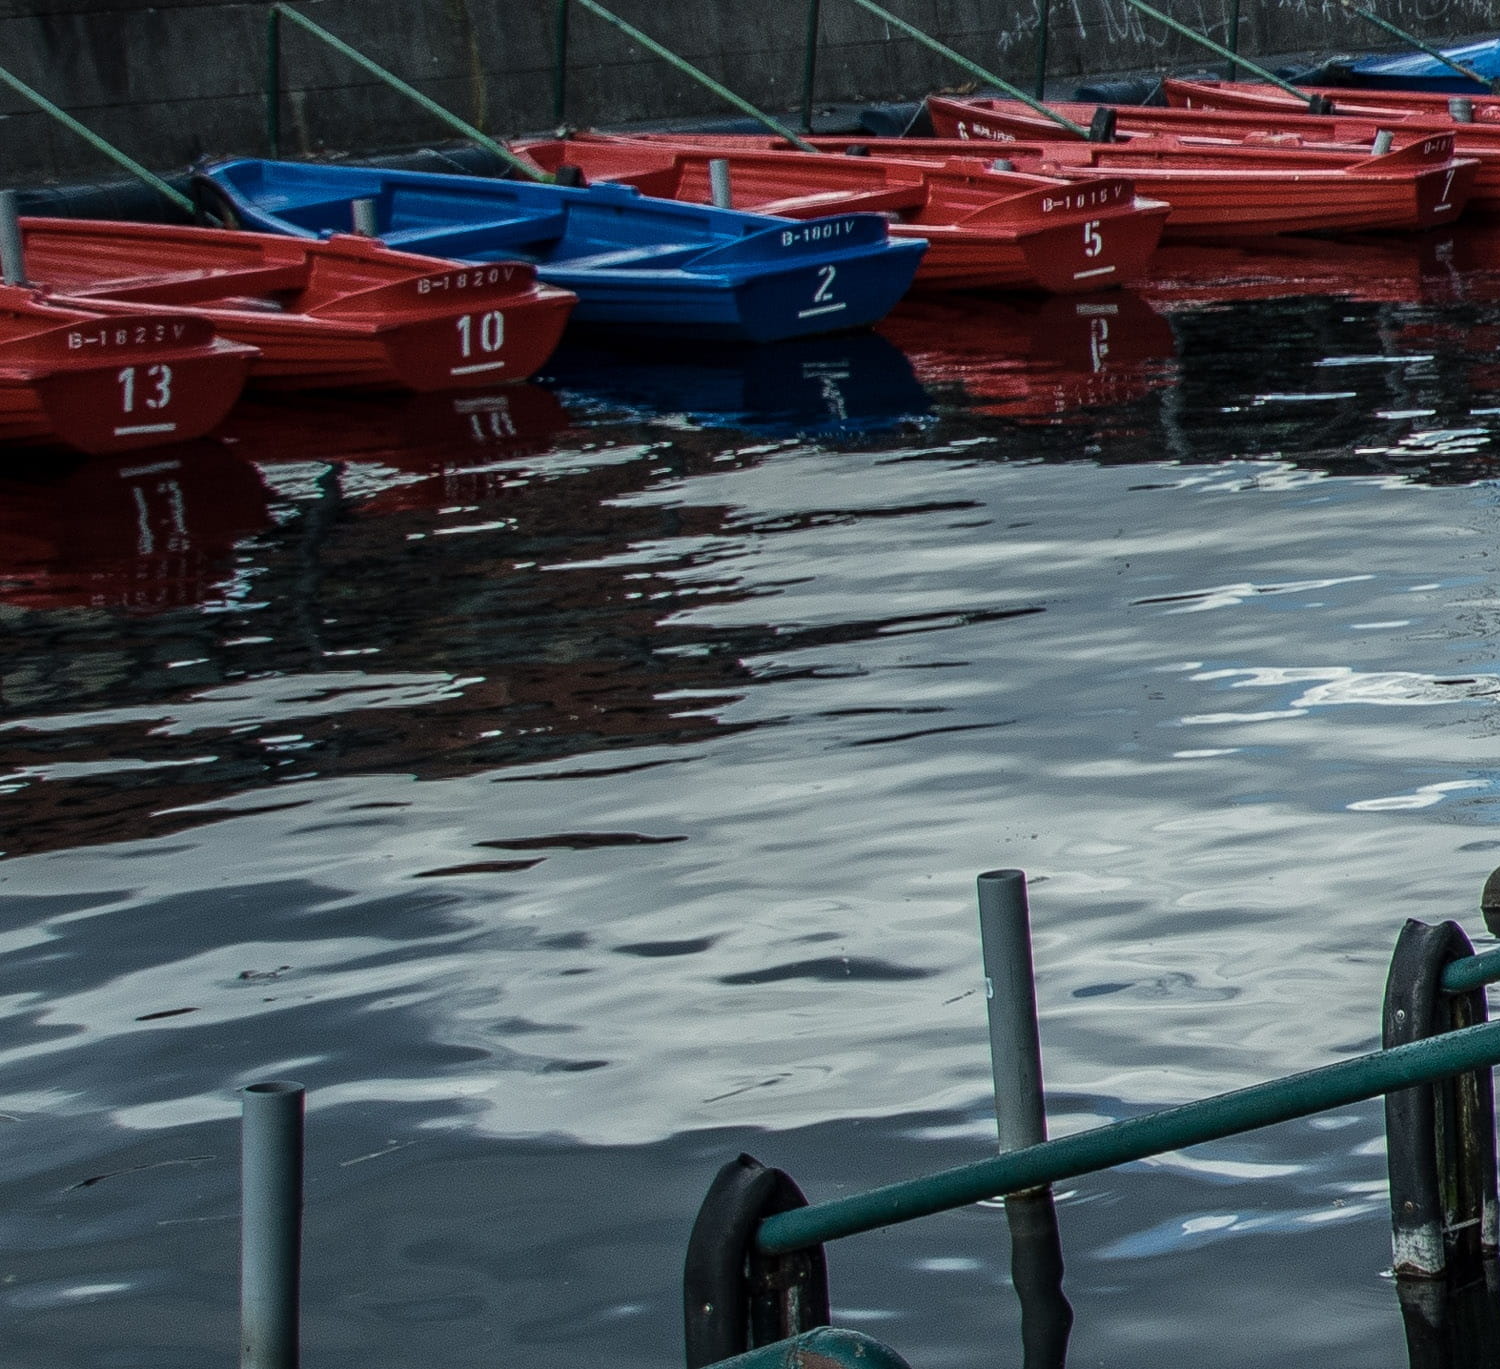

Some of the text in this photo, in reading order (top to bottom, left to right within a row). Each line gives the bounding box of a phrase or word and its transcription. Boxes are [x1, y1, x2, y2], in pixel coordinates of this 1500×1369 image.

[1442, 168, 1456, 203] 7
[782, 220, 855, 247] B-1801V
[1084, 220, 1102, 258] 5
[814, 264, 837, 303] 2
[456, 310, 505, 358] 10
[118, 364, 173, 414] 13
